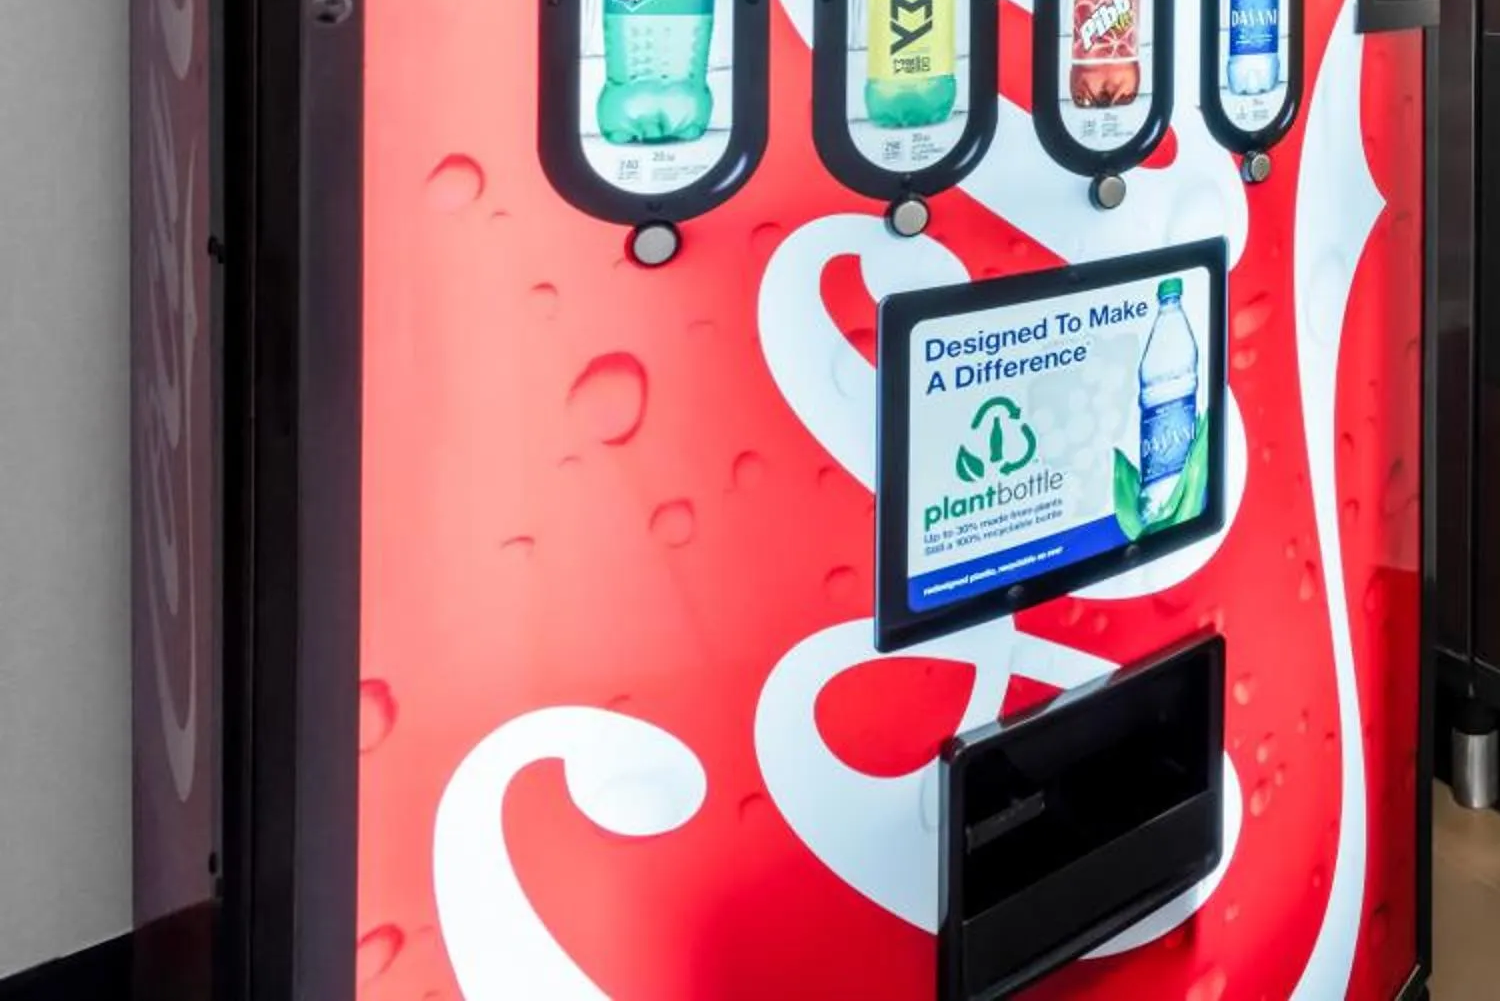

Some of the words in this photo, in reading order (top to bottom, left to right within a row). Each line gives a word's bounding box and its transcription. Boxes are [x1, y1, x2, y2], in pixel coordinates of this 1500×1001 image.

[925, 317, 1048, 363] Designed
[1055, 312, 1081, 336] To
[1089, 299, 1149, 329] Make
[926, 370, 947, 396] A
[955, 344, 1088, 390] Difference
[924, 469, 1064, 532] plantbottle
